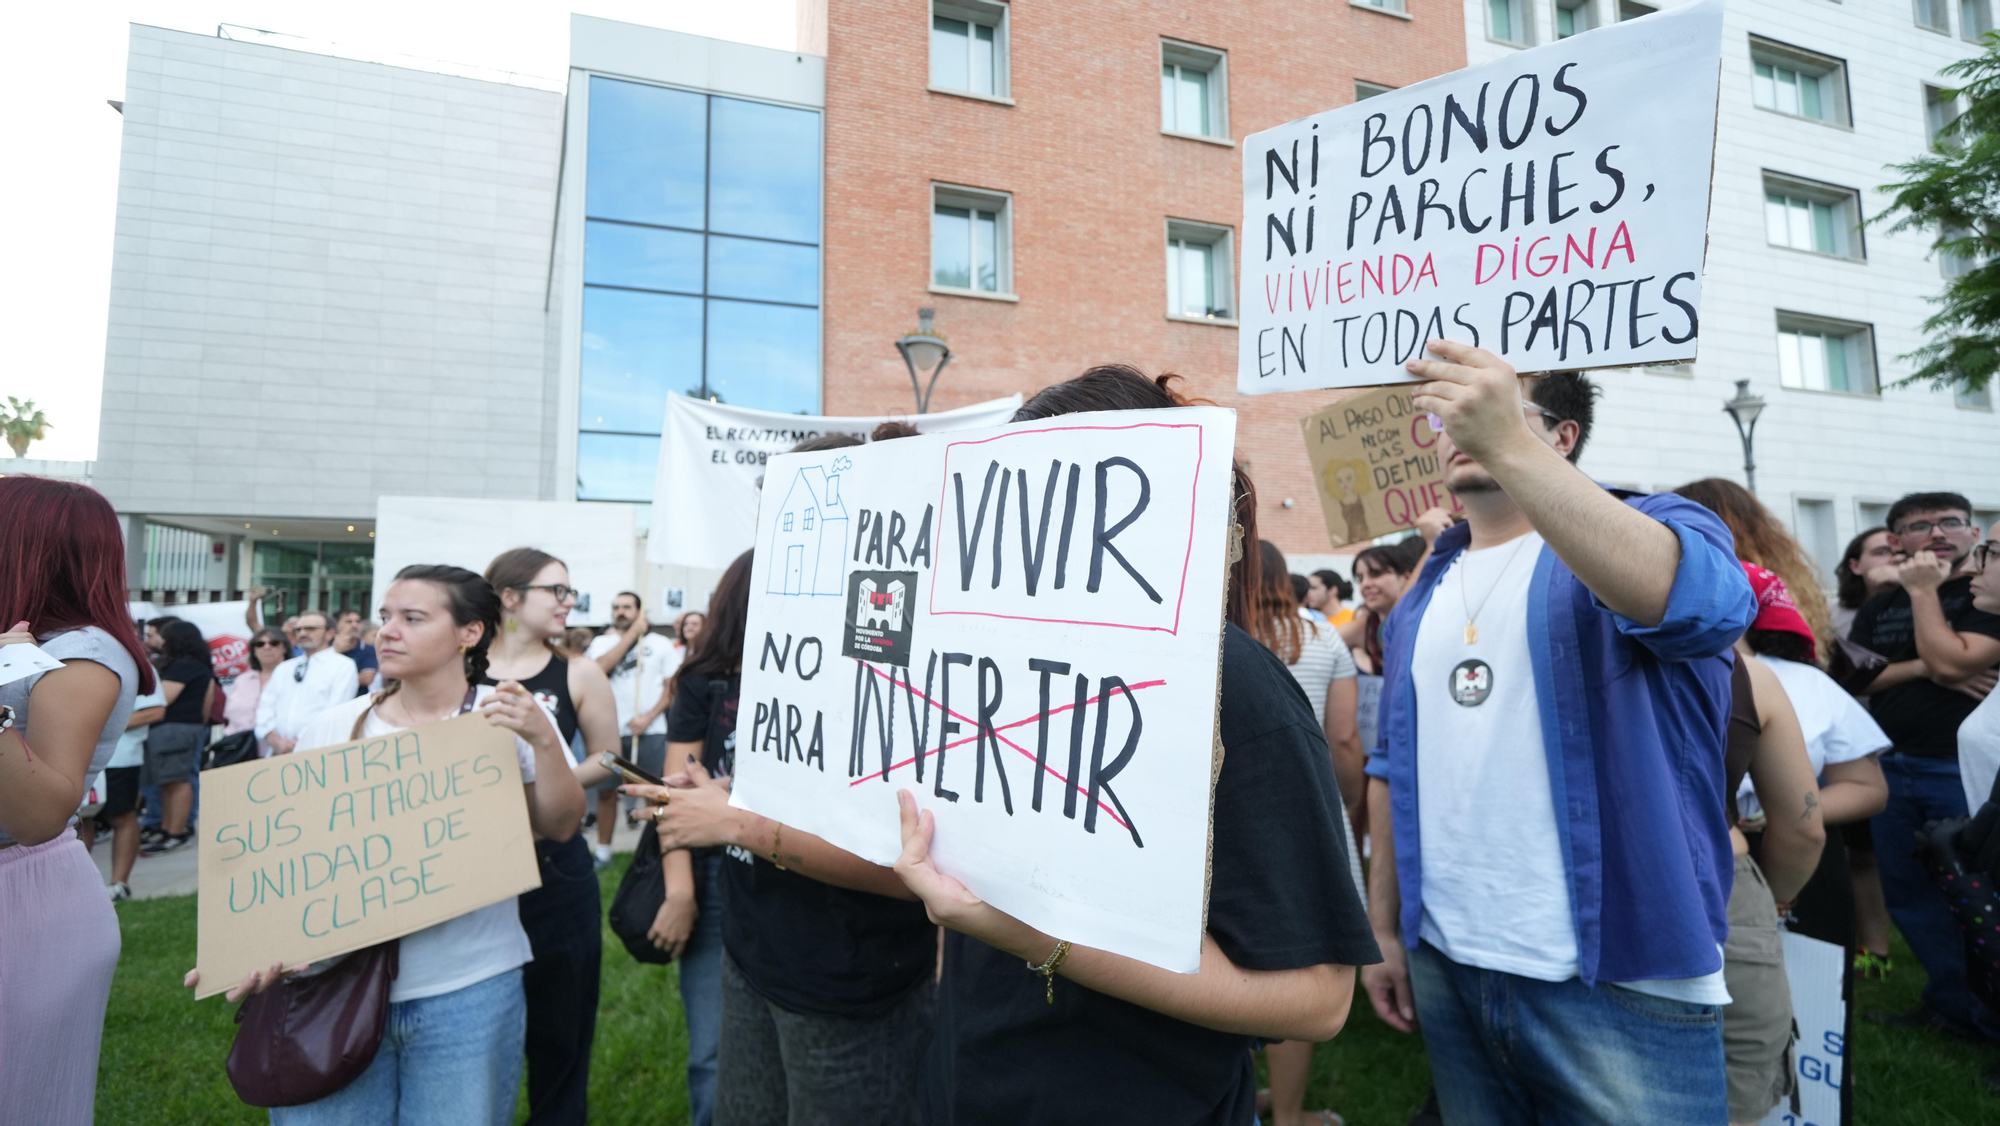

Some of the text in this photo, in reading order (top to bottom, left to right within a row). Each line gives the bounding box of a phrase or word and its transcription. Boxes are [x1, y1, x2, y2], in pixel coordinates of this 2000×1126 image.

[1361, 62, 1588, 178] BONOS
[1346, 144, 1656, 252] PARCHES,
[1258, 271, 1699, 378] EN TODAS PARTES
[705, 425, 723, 441] EL
[711, 449, 773, 466] EL GOB
[1319, 393, 1424, 444] AL PASO QU
[1368, 440, 1405, 465] LAS
[1411, 414, 1441, 449] C
[853, 456, 1163, 605] PARA VIVIR
[759, 631, 823, 681] NO
[855, 628, 884, 638] MOVIMIENTO
[246, 732, 423, 804] CONTRA
[751, 649, 1145, 849] PARA INVERTIR
[216, 754, 503, 861] SUS ATAQUES
[229, 808, 472, 914] UNIDAD DE
[302, 852, 456, 938] CLASE
